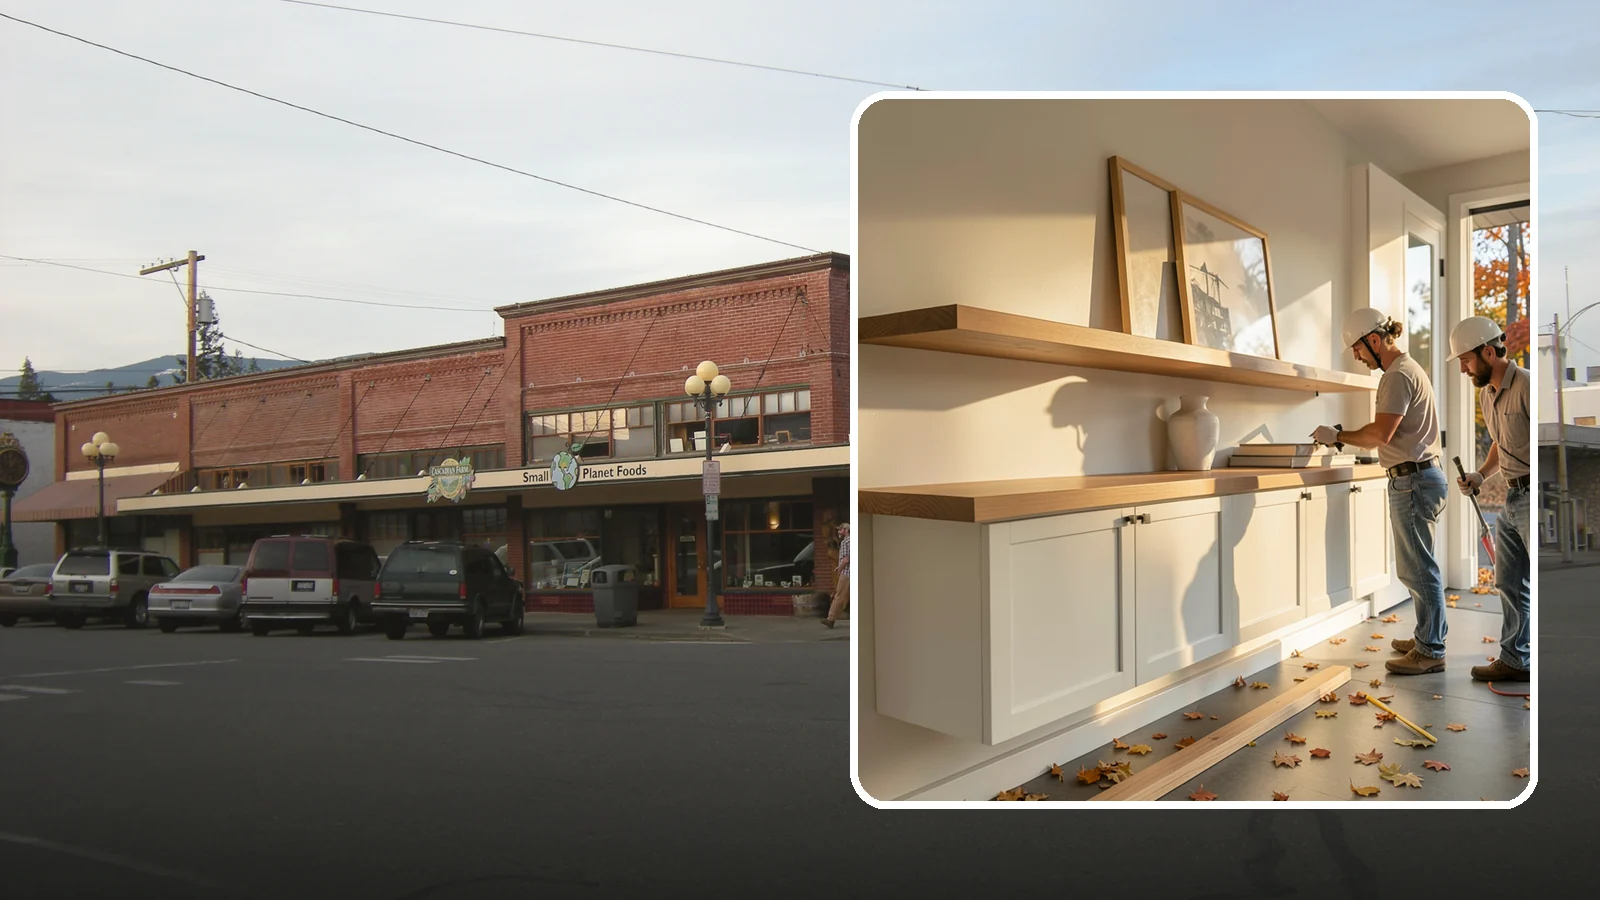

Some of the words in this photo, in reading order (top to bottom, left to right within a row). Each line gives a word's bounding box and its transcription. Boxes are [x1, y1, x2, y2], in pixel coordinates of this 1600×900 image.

[456, 465, 469, 474] FARM
[523, 471, 549, 483] Small
[583, 467, 614, 479] Planet
[617, 464, 647, 477] Foods
